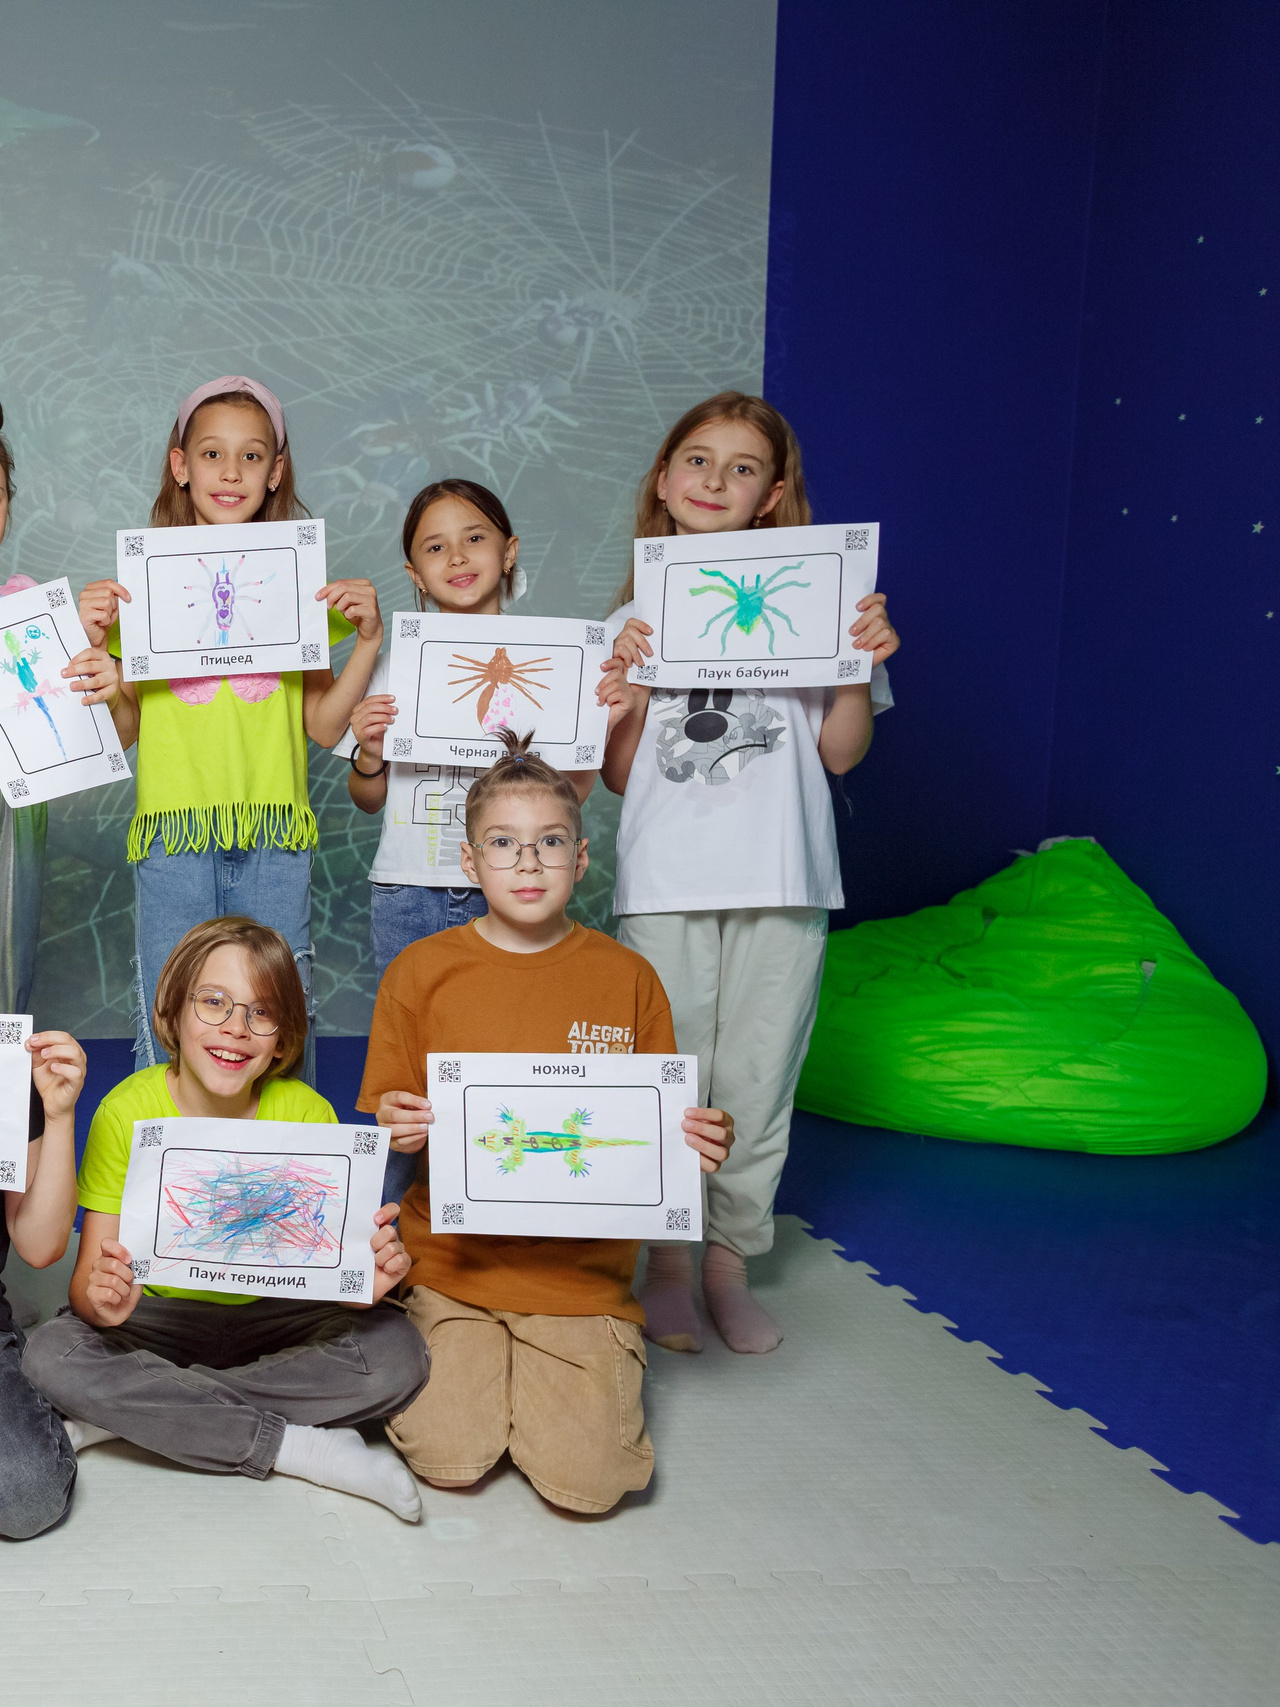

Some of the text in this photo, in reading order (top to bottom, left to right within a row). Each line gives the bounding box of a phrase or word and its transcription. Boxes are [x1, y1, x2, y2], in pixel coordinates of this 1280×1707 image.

[200, 655, 253, 666] Птицеед
[697, 666, 789, 680] Паук бабуин
[449, 745, 497, 759] Черная
[532, 1065, 586, 1078] Геккон
[189, 1266, 307, 1289] Паук теридиид
